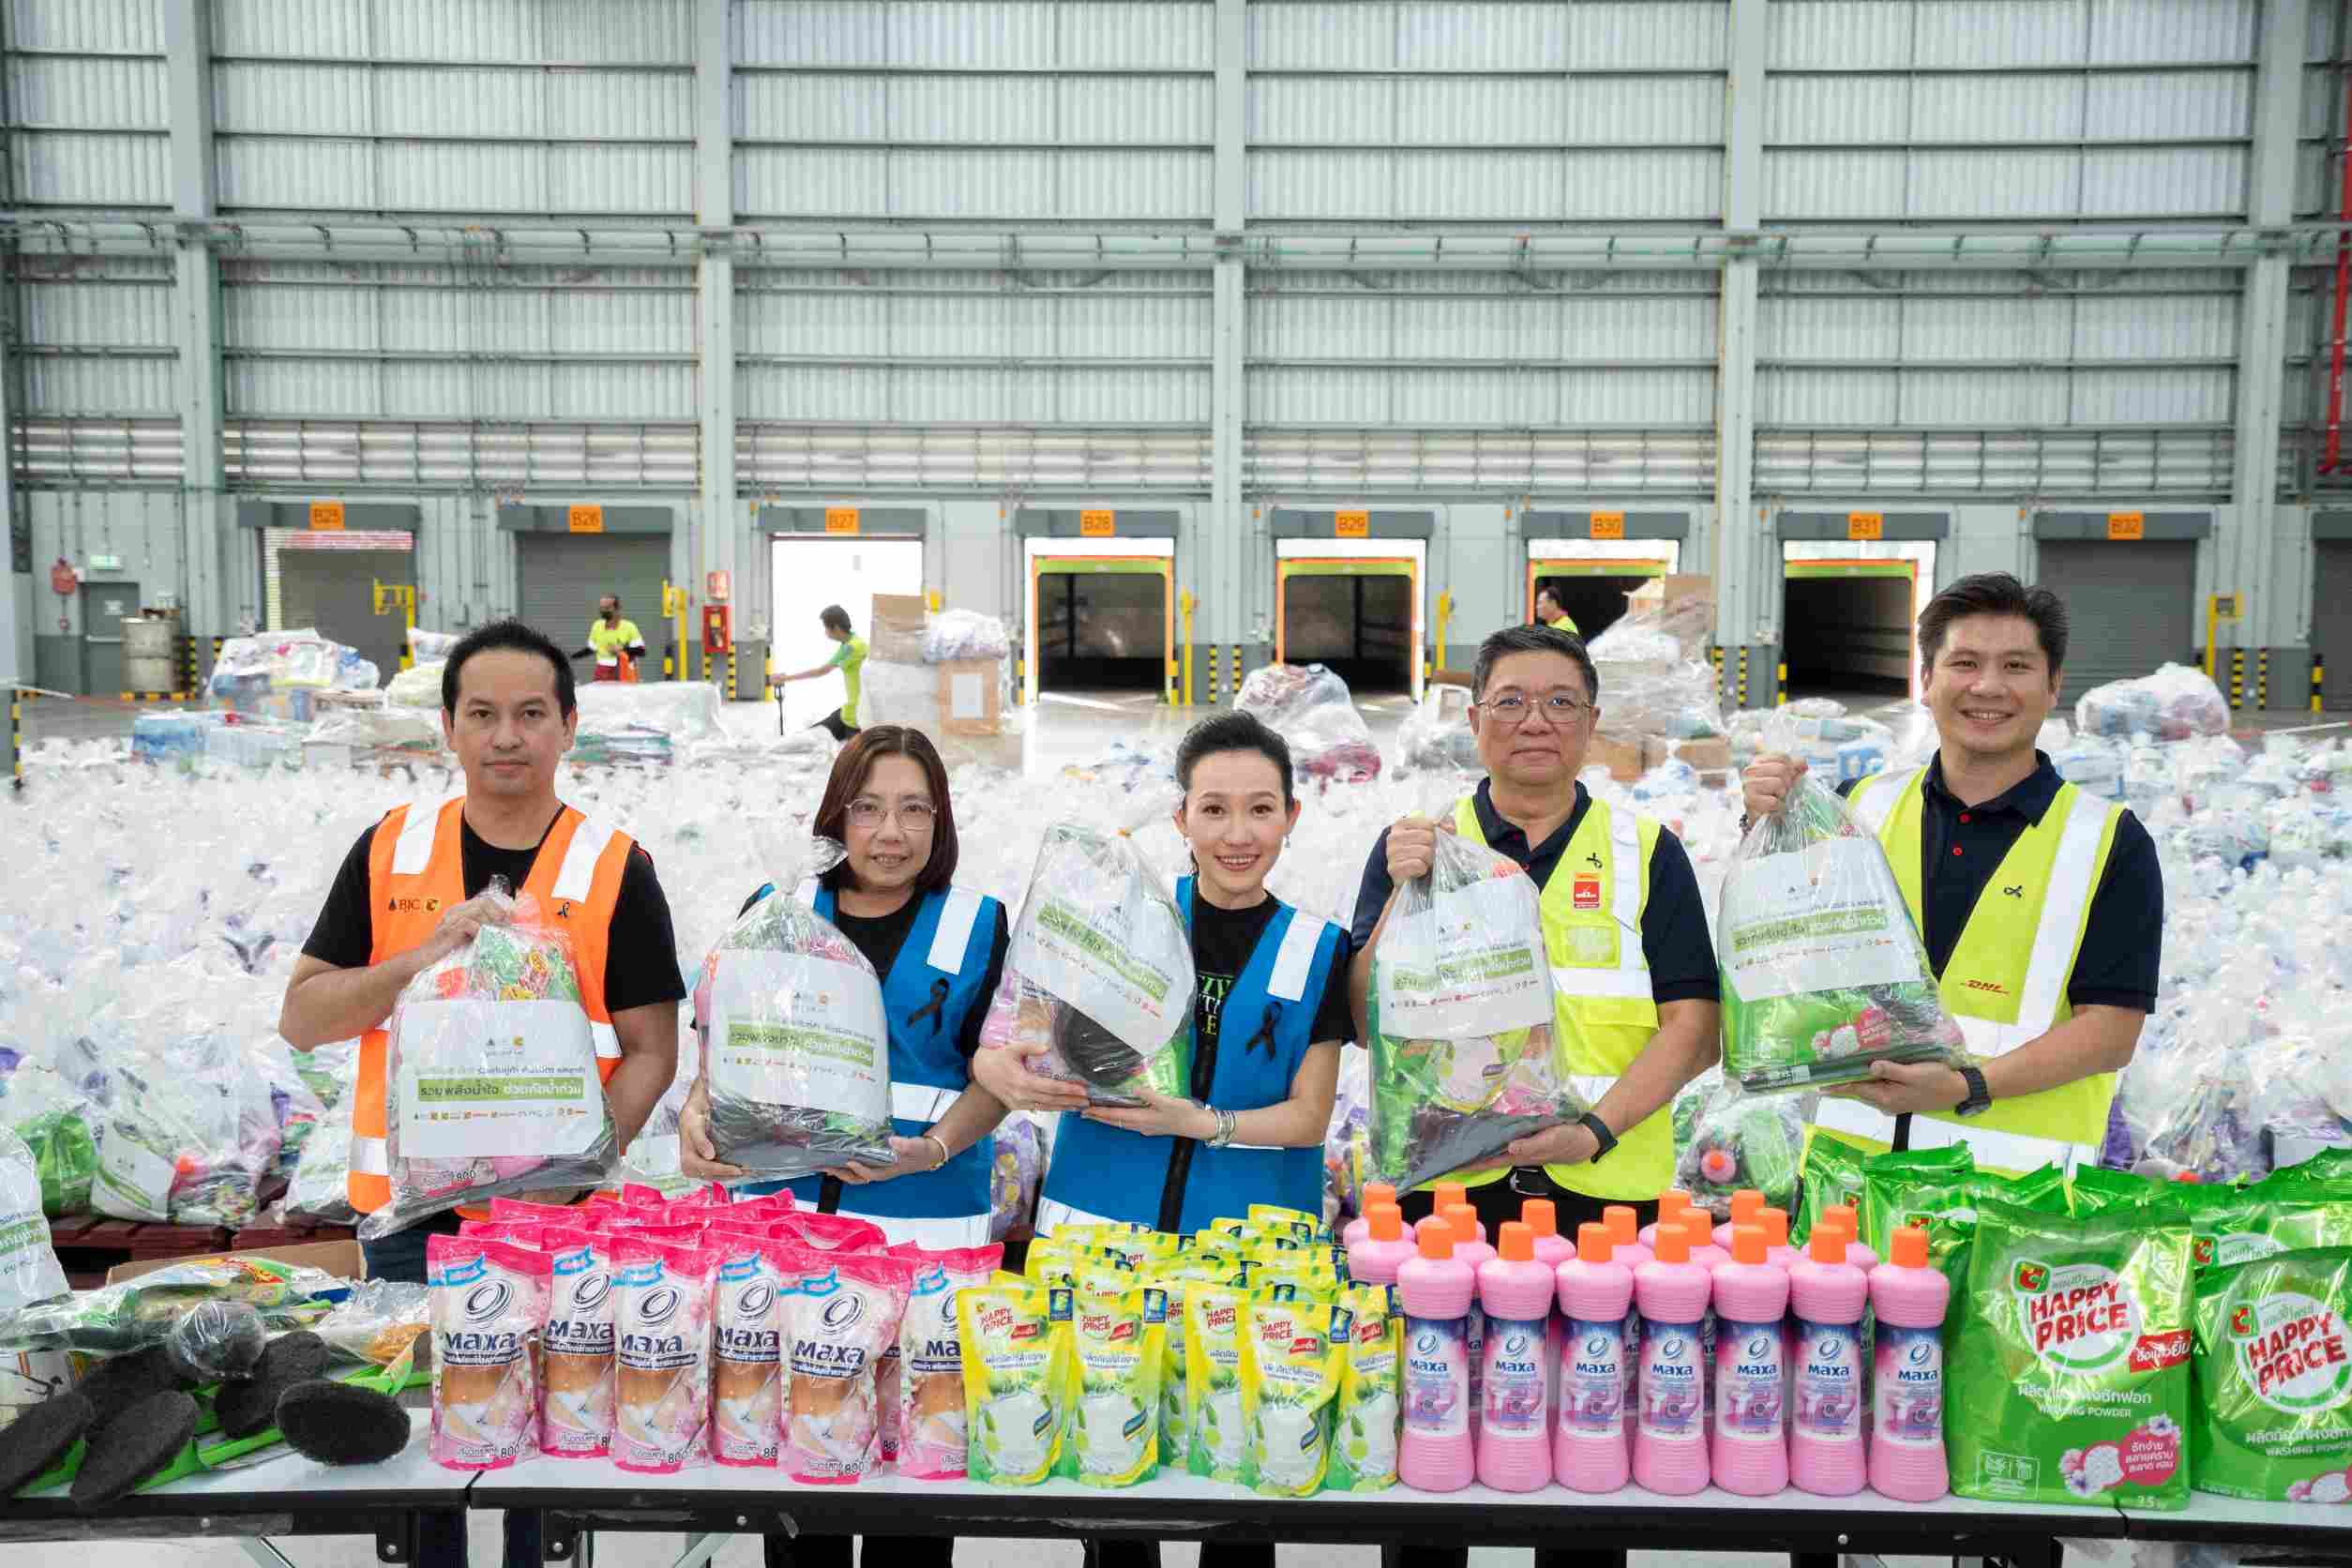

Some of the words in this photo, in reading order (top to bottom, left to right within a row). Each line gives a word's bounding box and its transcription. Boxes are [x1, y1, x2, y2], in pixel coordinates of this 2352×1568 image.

[314, 509, 339, 524] B25
[572, 511, 599, 526] B26
[828, 513, 855, 529] B27
[1338, 515, 1365, 531] B29
[1592, 518, 1622, 534] B30
[1851, 518, 1879, 534] B31
[2030, 1281, 2119, 1322] HAPPY
[547, 1319, 614, 1339] Maxa
[1260, 1320, 1292, 1334] HAPPY
[2036, 1303, 2132, 1351] PRICE
[446, 1332, 517, 1351] Maxa
[621, 1334, 683, 1352] Maxa
[716, 1326, 779, 1348] Maxa
[1261, 1329, 1293, 1342] PRICE
[2247, 1312, 2333, 1369] HAPPY
[796, 1339, 865, 1364] Maxa
[926, 1339, 960, 1357] Ma
[1410, 1358, 1448, 1372] Maxa
[1495, 1361, 1536, 1373] Maxa
[1576, 1362, 1616, 1374] Maxa
[1652, 1364, 1694, 1376] Maxa
[1737, 1364, 1777, 1376] Maxa
[1808, 1364, 1849, 1377] Maxa
[2257, 1334, 2347, 1395] PRICE
[1899, 1369, 1938, 1381] Maxa
